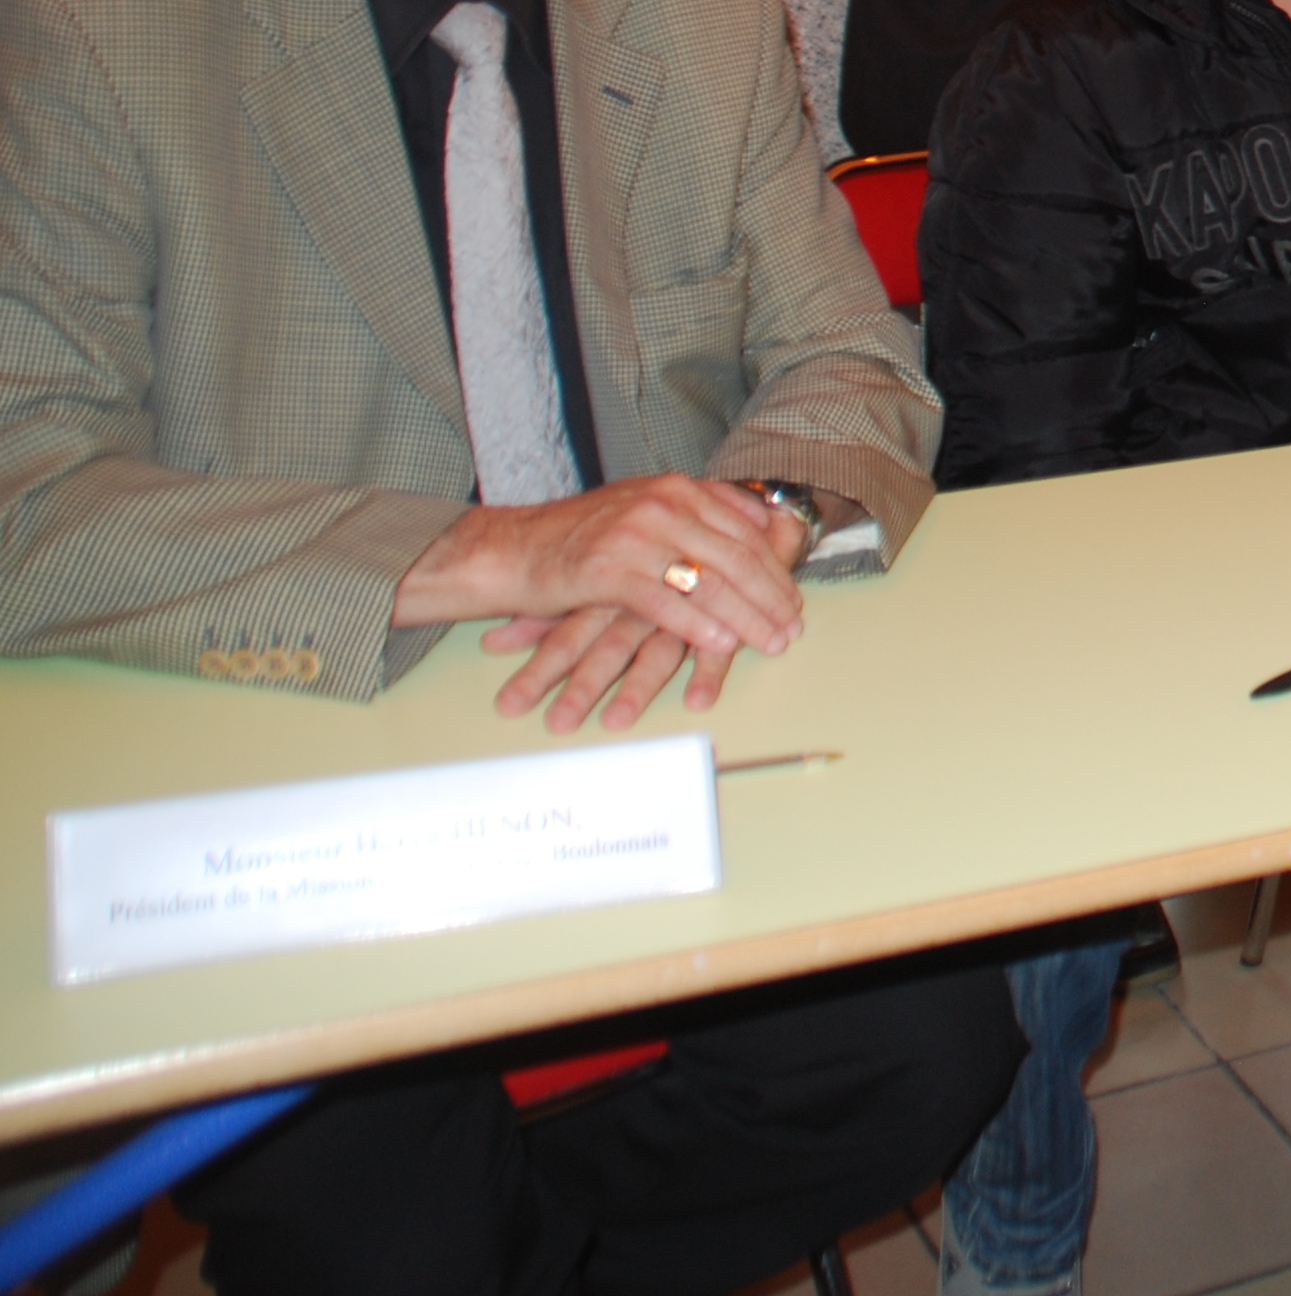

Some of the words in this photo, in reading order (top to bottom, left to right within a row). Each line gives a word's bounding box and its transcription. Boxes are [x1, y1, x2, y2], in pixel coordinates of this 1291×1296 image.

[108, 892, 217, 925] Président
[224, 883, 250, 907] de
[260, 882, 278, 903] la
